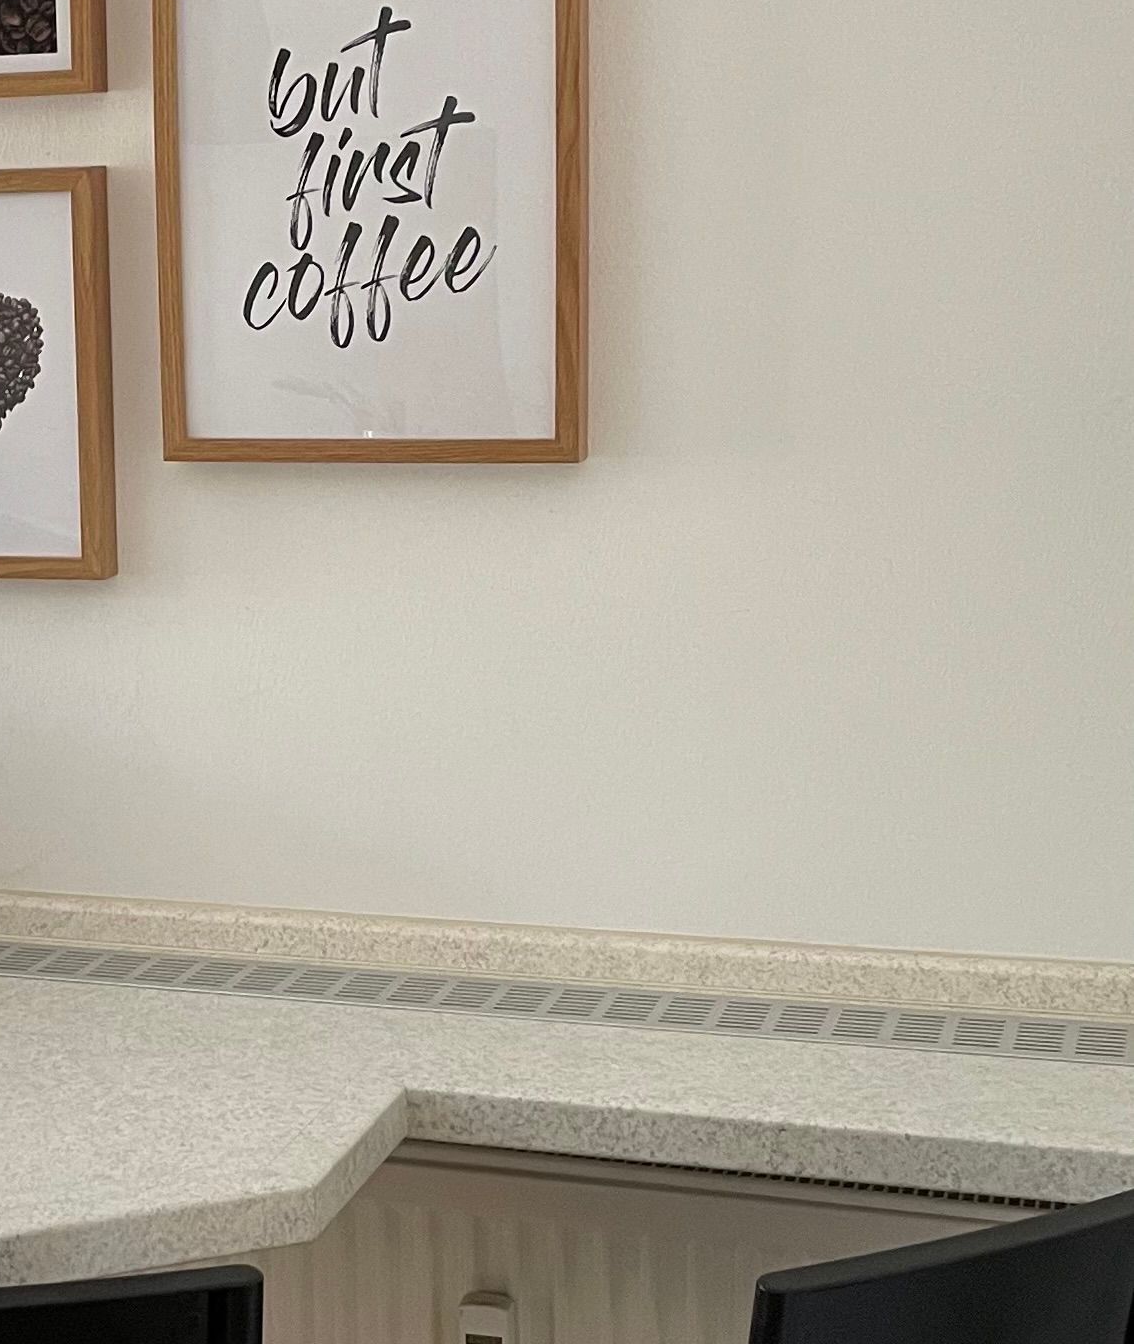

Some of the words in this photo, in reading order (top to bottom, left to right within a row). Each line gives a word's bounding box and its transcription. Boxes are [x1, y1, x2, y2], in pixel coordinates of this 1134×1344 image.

[267, 6, 412, 138] but
[285, 96, 476, 251] first
[242, 215, 498, 349] coffee
